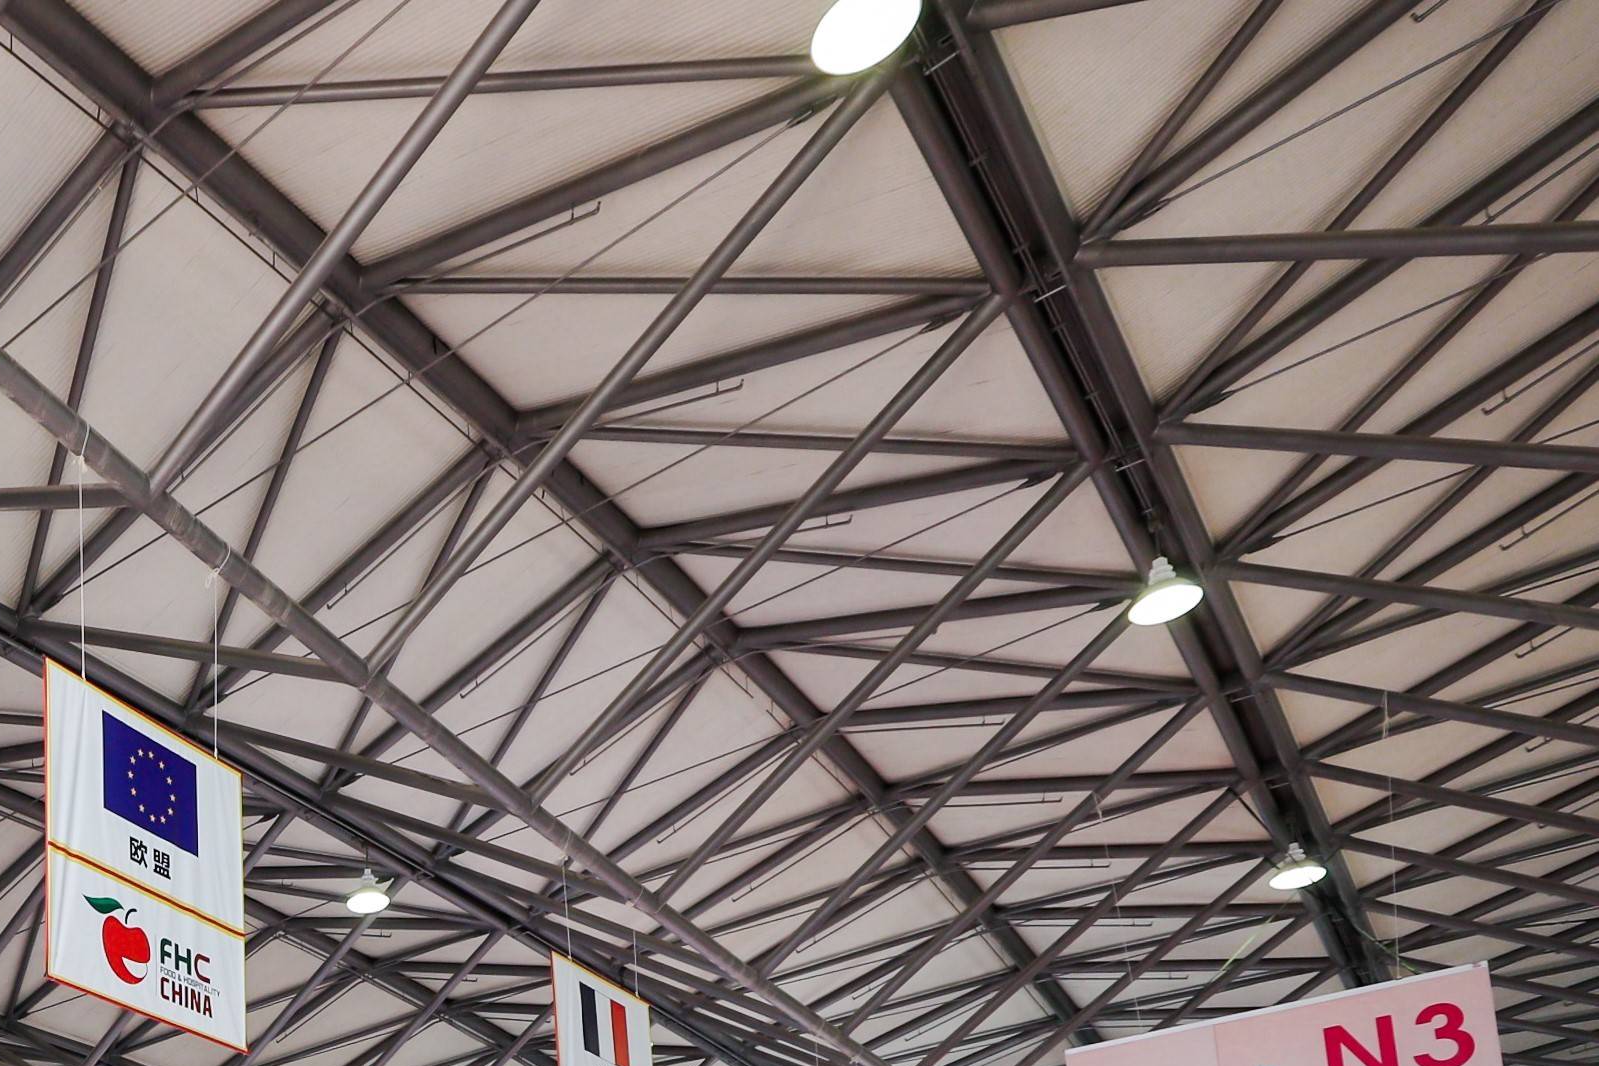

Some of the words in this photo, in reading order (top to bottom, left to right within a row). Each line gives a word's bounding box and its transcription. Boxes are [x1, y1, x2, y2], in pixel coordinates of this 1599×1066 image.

[129, 836, 171, 880] 欧盟
[160, 938, 211, 984] FHC
[160, 966, 177, 981] FOOD
[184, 977, 221, 998] HOSPITALITY
[160, 976, 213, 1018] CHINA
